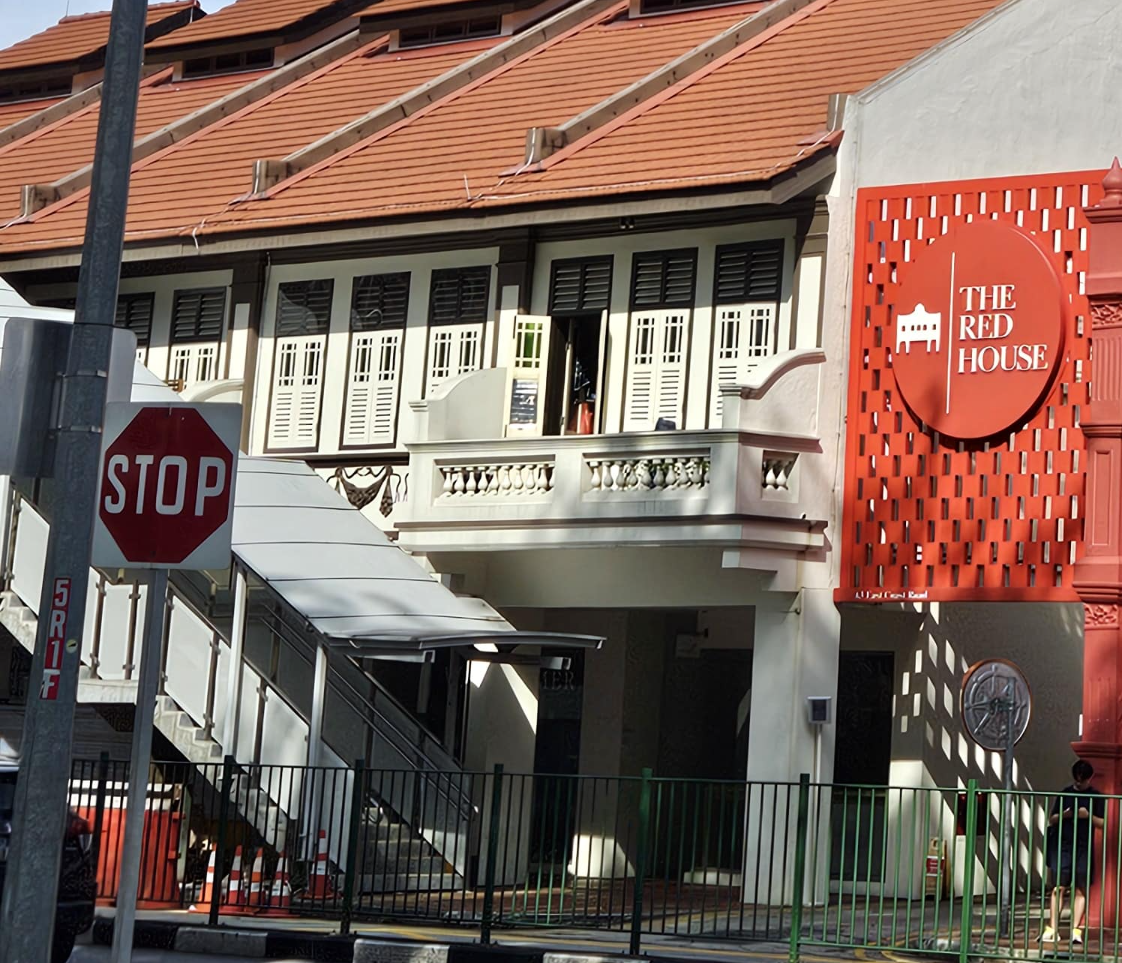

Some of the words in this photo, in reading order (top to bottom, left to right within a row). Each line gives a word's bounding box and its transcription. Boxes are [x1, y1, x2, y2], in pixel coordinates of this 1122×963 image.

[959, 284, 1017, 312] THE
[959, 313, 1014, 340] RED
[957, 344, 1049, 374] HOUSE
[104, 454, 226, 516] STOP
